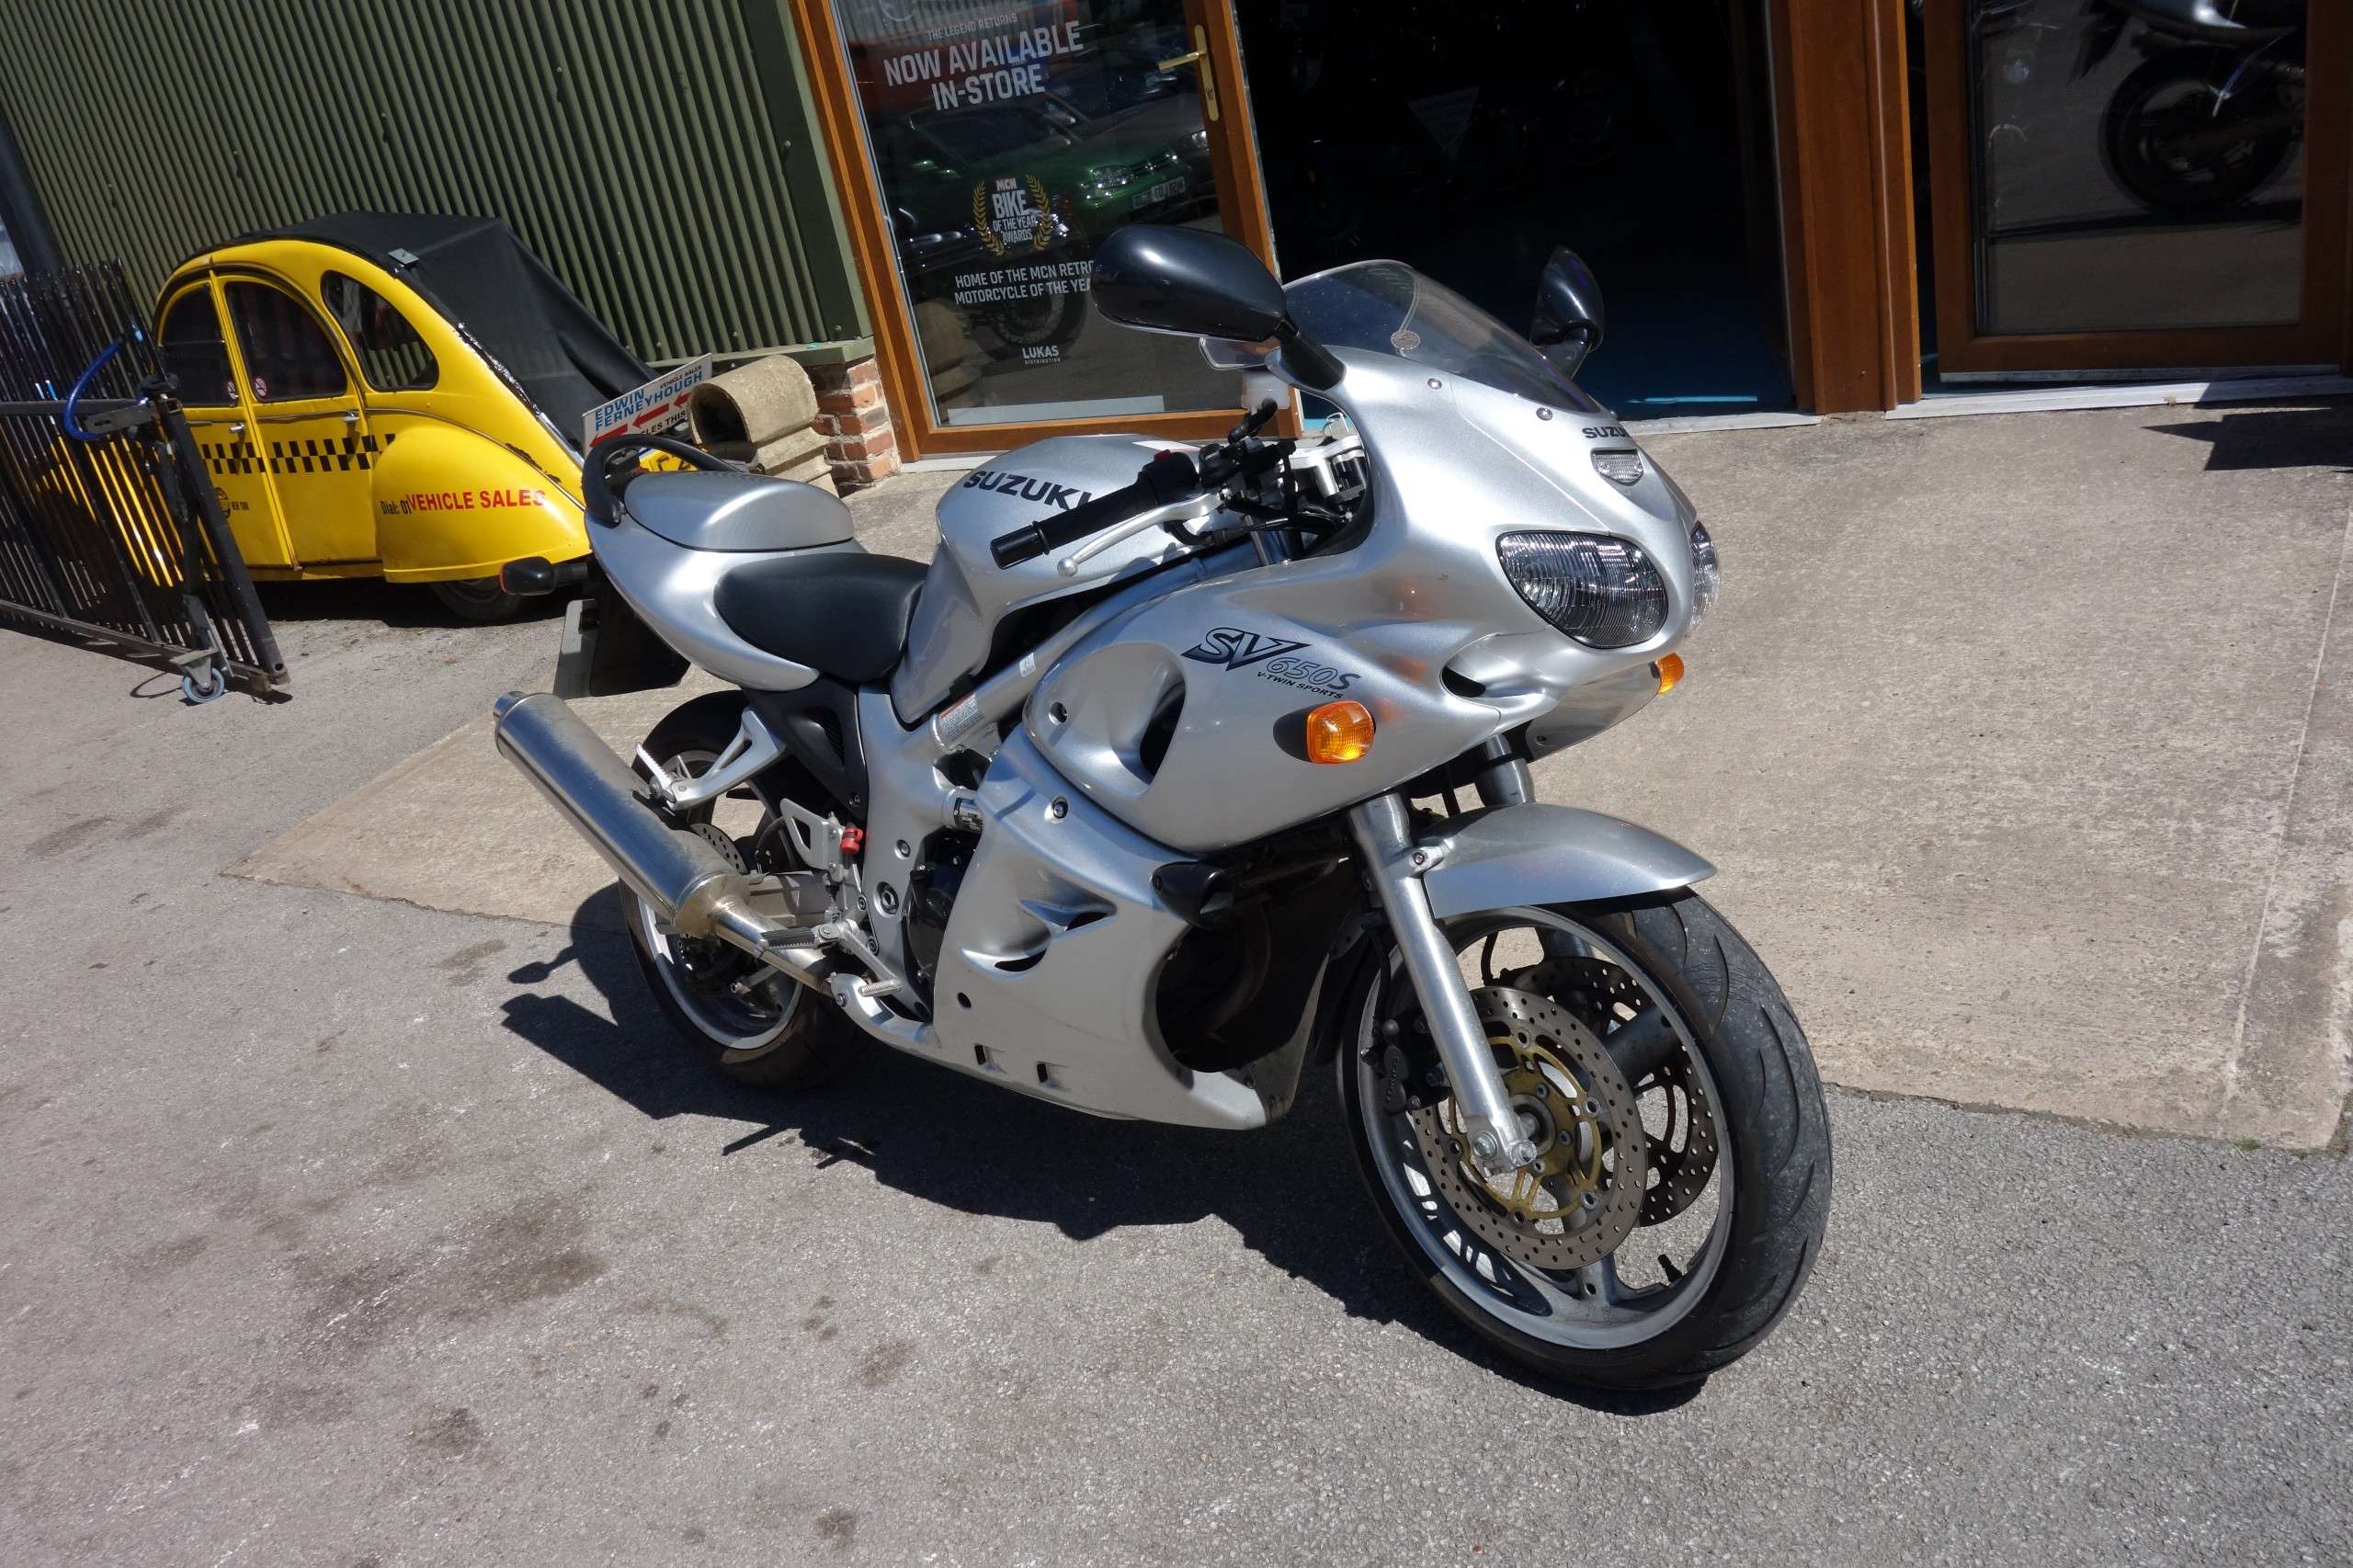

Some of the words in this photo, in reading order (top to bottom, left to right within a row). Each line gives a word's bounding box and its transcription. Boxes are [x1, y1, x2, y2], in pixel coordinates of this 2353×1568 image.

[926, 29, 944, 41] THE
[944, 21, 977, 39] LEGEND
[978, 13, 1018, 30] RETURNS
[883, 49, 942, 86] NOW
[949, 20, 1085, 75] AVAILABLE
[931, 63, 1046, 111] IN-STORE
[992, 189, 1029, 219] BIKE
[993, 220, 1002, 232] OF
[1002, 218, 1017, 231] THE
[1017, 214, 1038, 230] YEAR
[1001, 229, 1033, 244] AWARDS
[955, 272, 988, 289] HOME
[990, 270, 1004, 284] OF
[1006, 267, 1029, 282] THE
[1029, 264, 1057, 280] MCN
[954, 285, 1029, 305] MOTORCYCLE
[1029, 283, 1044, 297] OF
[1045, 280, 1069, 295] THE
[1022, 345, 1060, 359] LUKAS
[596, 370, 702, 431] FERNEYHOUGH
[596, 389, 644, 421] EDWIN
[665, 410, 686, 426] THIS
[381, 499, 400, 516] Dial:
[406, 491, 475, 511] VEHICLE
[479, 489, 546, 509] SALES
[1180, 627, 1313, 671] SV
[1266, 657, 1361, 690] 650S
[1256, 671, 1296, 687] V-TWIN
[1296, 682, 1345, 699] SPORTS
